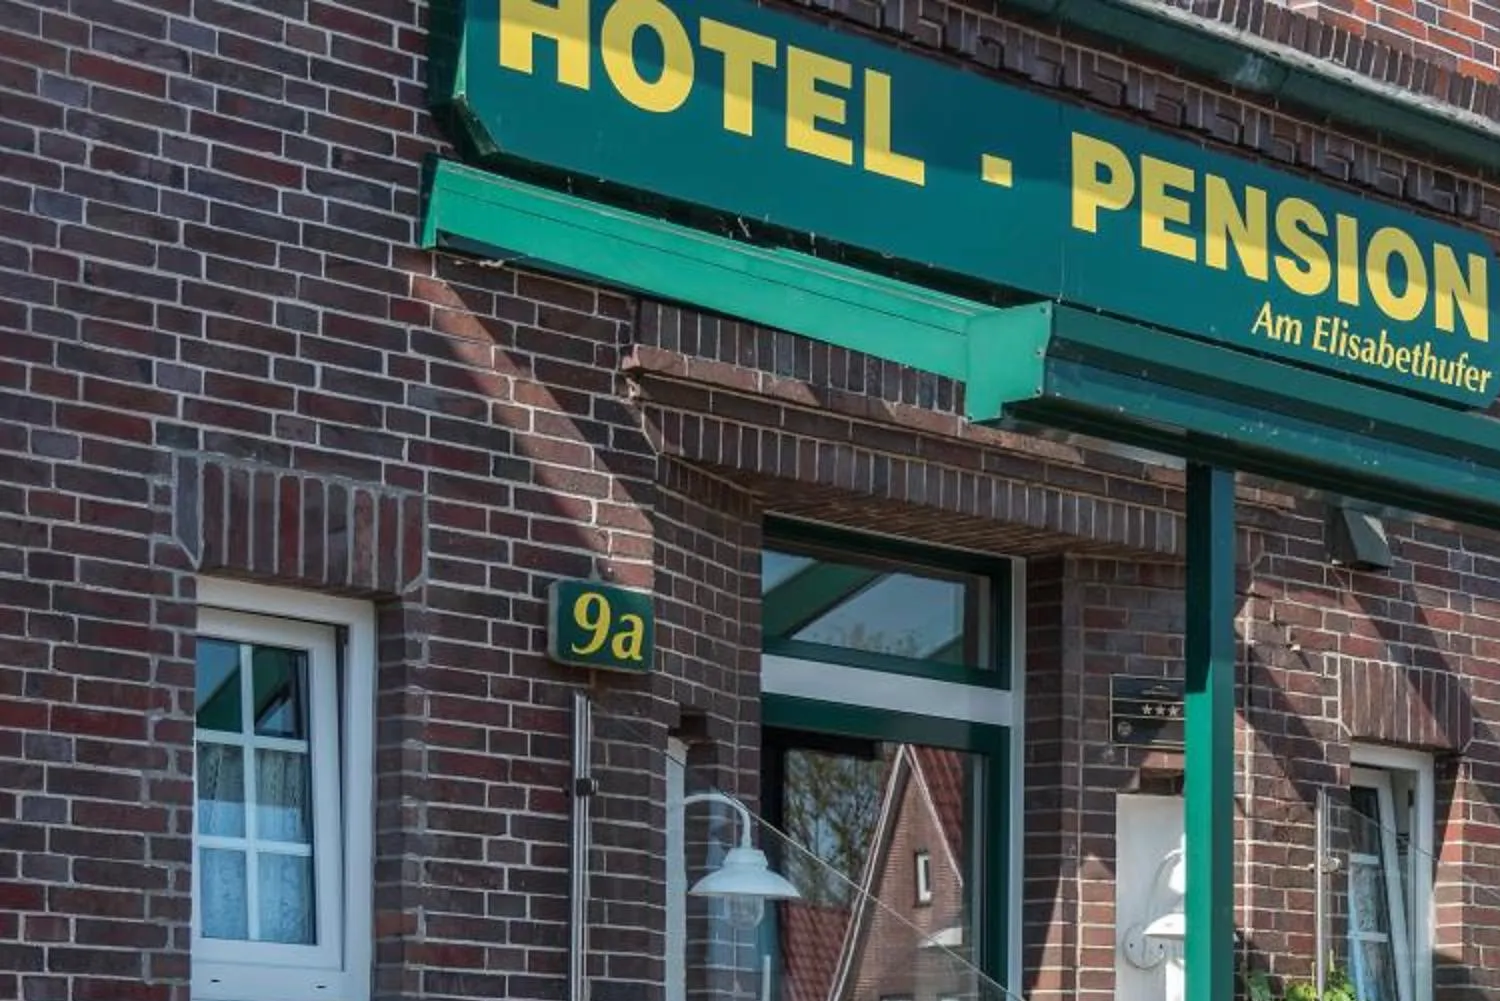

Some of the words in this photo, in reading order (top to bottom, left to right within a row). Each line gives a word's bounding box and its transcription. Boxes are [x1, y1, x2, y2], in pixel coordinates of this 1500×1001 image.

[499, 0, 926, 187] HOTEL
[1071, 133, 1489, 343] PENSION
[1250, 300, 1304, 346] Am
[1311, 314, 1493, 394] Elisabethufer
[571, 591, 645, 661] 9a
